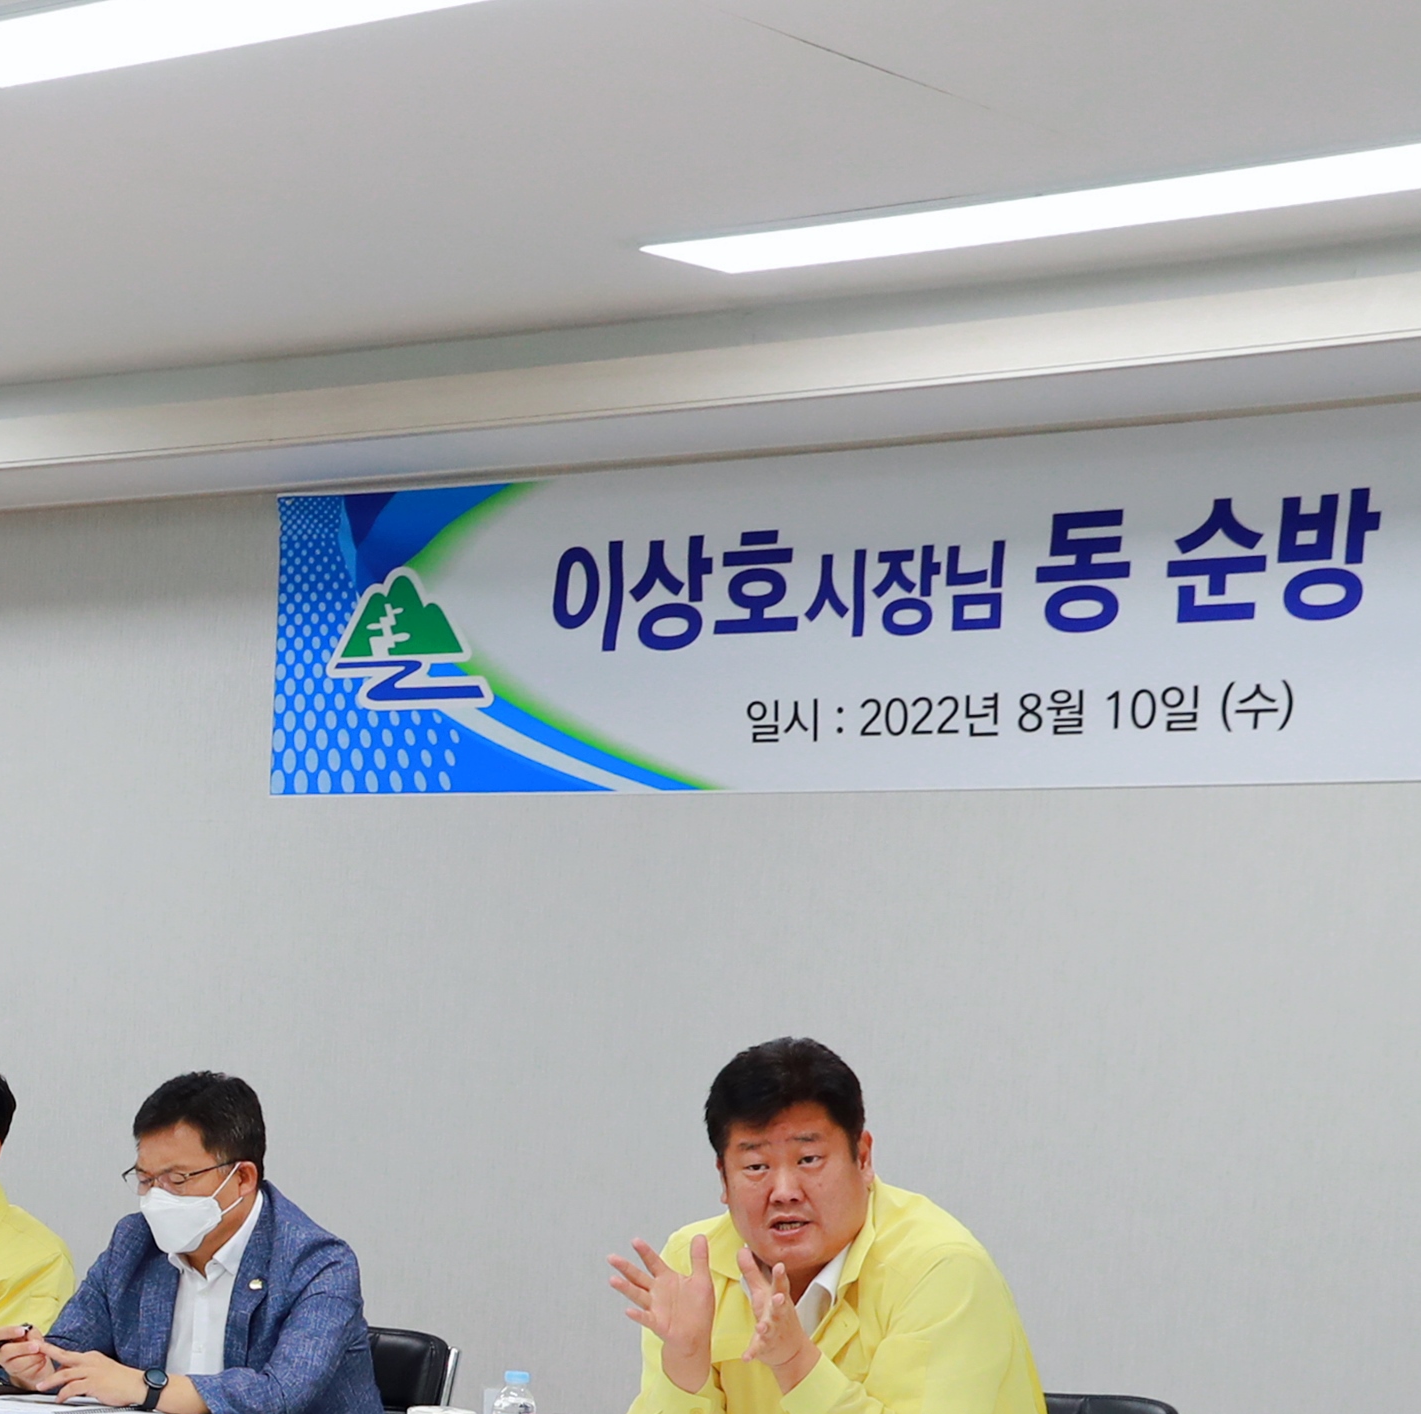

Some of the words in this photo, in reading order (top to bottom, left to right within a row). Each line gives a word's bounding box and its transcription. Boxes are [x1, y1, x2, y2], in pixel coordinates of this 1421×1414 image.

[1034, 507, 1132, 634] 동
[1165, 485, 1383, 624] 순방
[746, 697, 819, 744] 일시
[859, 691, 999, 738] 2022년
[1017, 688, 1085, 736] 8월
[1106, 684, 1199, 733] 10일
[1220, 679, 1294, 733] (수)
